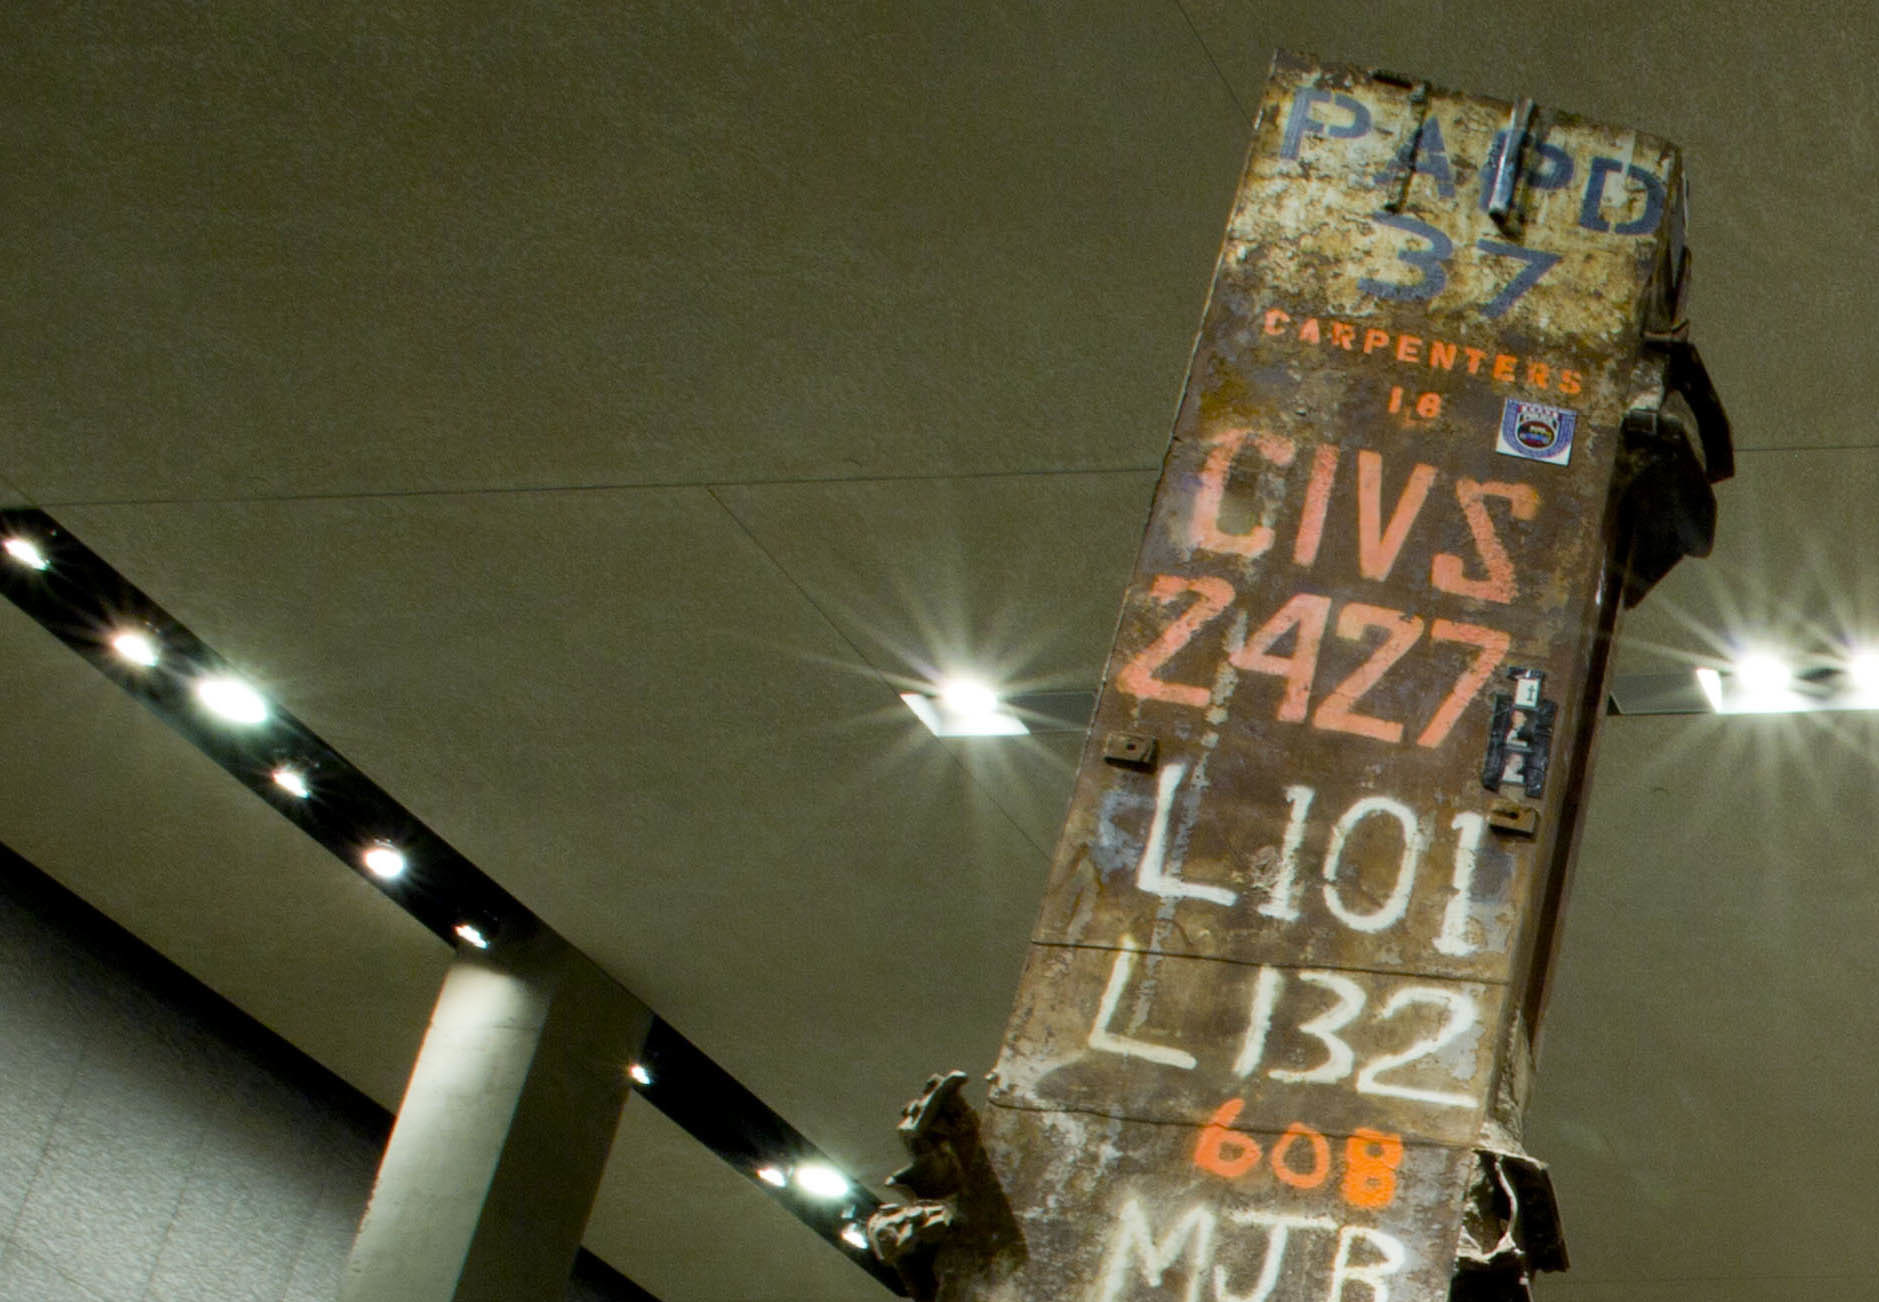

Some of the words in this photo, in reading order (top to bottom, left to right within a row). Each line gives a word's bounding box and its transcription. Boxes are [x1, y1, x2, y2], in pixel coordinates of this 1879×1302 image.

[1280, 89, 1667, 235] PAPD
[1357, 210, 1563, 317] 37
[1263, 308, 1583, 396] CARPENTERS
[1388, 386, 1443, 418] 18
[1194, 429, 1542, 604] CIVS
[1114, 575, 1512, 748] 2427
[1137, 763, 1490, 957] L101
[1088, 935, 1480, 1108] L132
[1193, 1099, 1404, 1208] 608
